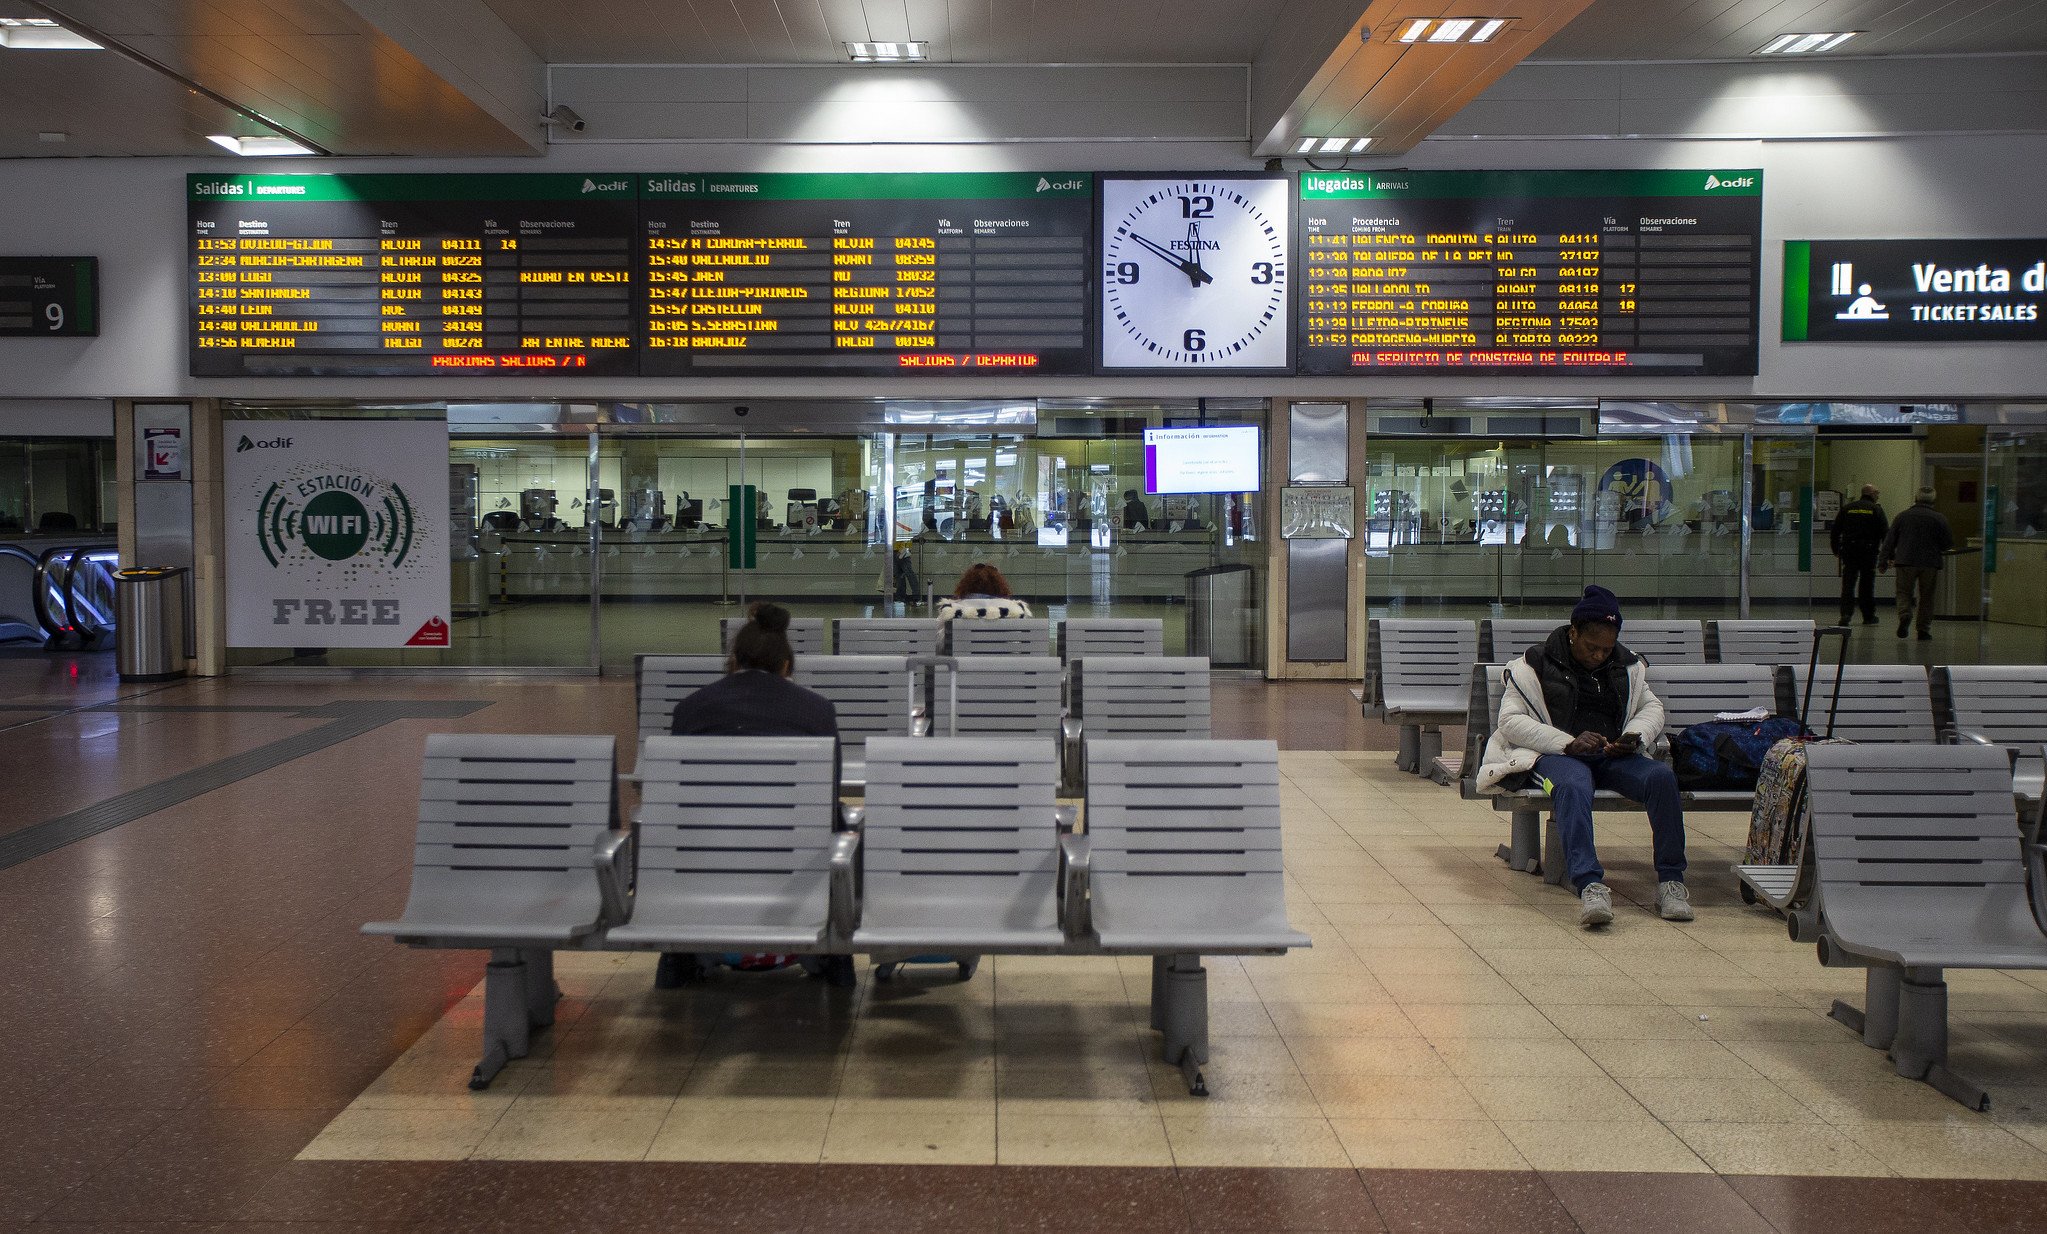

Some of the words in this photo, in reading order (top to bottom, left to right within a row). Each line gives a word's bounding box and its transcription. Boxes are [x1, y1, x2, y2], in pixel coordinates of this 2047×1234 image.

[195, 182, 244, 195] Salidas
[256, 186, 306, 195] DEPARTURES
[598, 181, 629, 191] adif
[648, 180, 697, 193] Salidas
[710, 184, 759, 193] DEPARTURES
[1052, 179, 1084, 190] adif
[1307, 177, 1364, 193] Llegadas
[1376, 181, 1409, 190] ARRIVALS
[1721, 176, 1754, 188] adif
[1177, 195, 1215, 219] 12
[196, 220, 216, 229] Hora
[238, 219, 268, 229] Destino
[381, 220, 399, 229] Tren
[519, 219, 576, 229] Observaciones
[648, 220, 667, 229] Hora
[690, 220, 720, 229] Destino
[833, 219, 852, 228] Tren
[937, 218, 951, 228] Vía
[973, 218, 1030, 228] Observaciones
[1307, 217, 1327, 226] Hora
[1352, 217, 1400, 226] Procedencia
[1497, 217, 1514, 226] Tren
[1603, 216, 1616, 225] Vía
[1639, 216, 1697, 225] Observaciones
[502, 239, 517, 250] 14
[1169, 240, 1222, 251] FESTINA
[1116, 262, 1140, 285] 9
[1250, 262, 1274, 285] 3
[1911, 263, 2010, 292] Venta
[1619, 284, 1636, 296] 17
[45, 302, 64, 331] 9
[1909, 305, 1978, 322] TICKET
[1978, 305, 2039, 322] SALES
[1183, 328, 1206, 352] 6
[256, 436, 295, 449] adif
[1156, 433, 1200, 441] Información
[297, 473, 375, 499] ESTACIÓN
[272, 598, 401, 626] FREE
